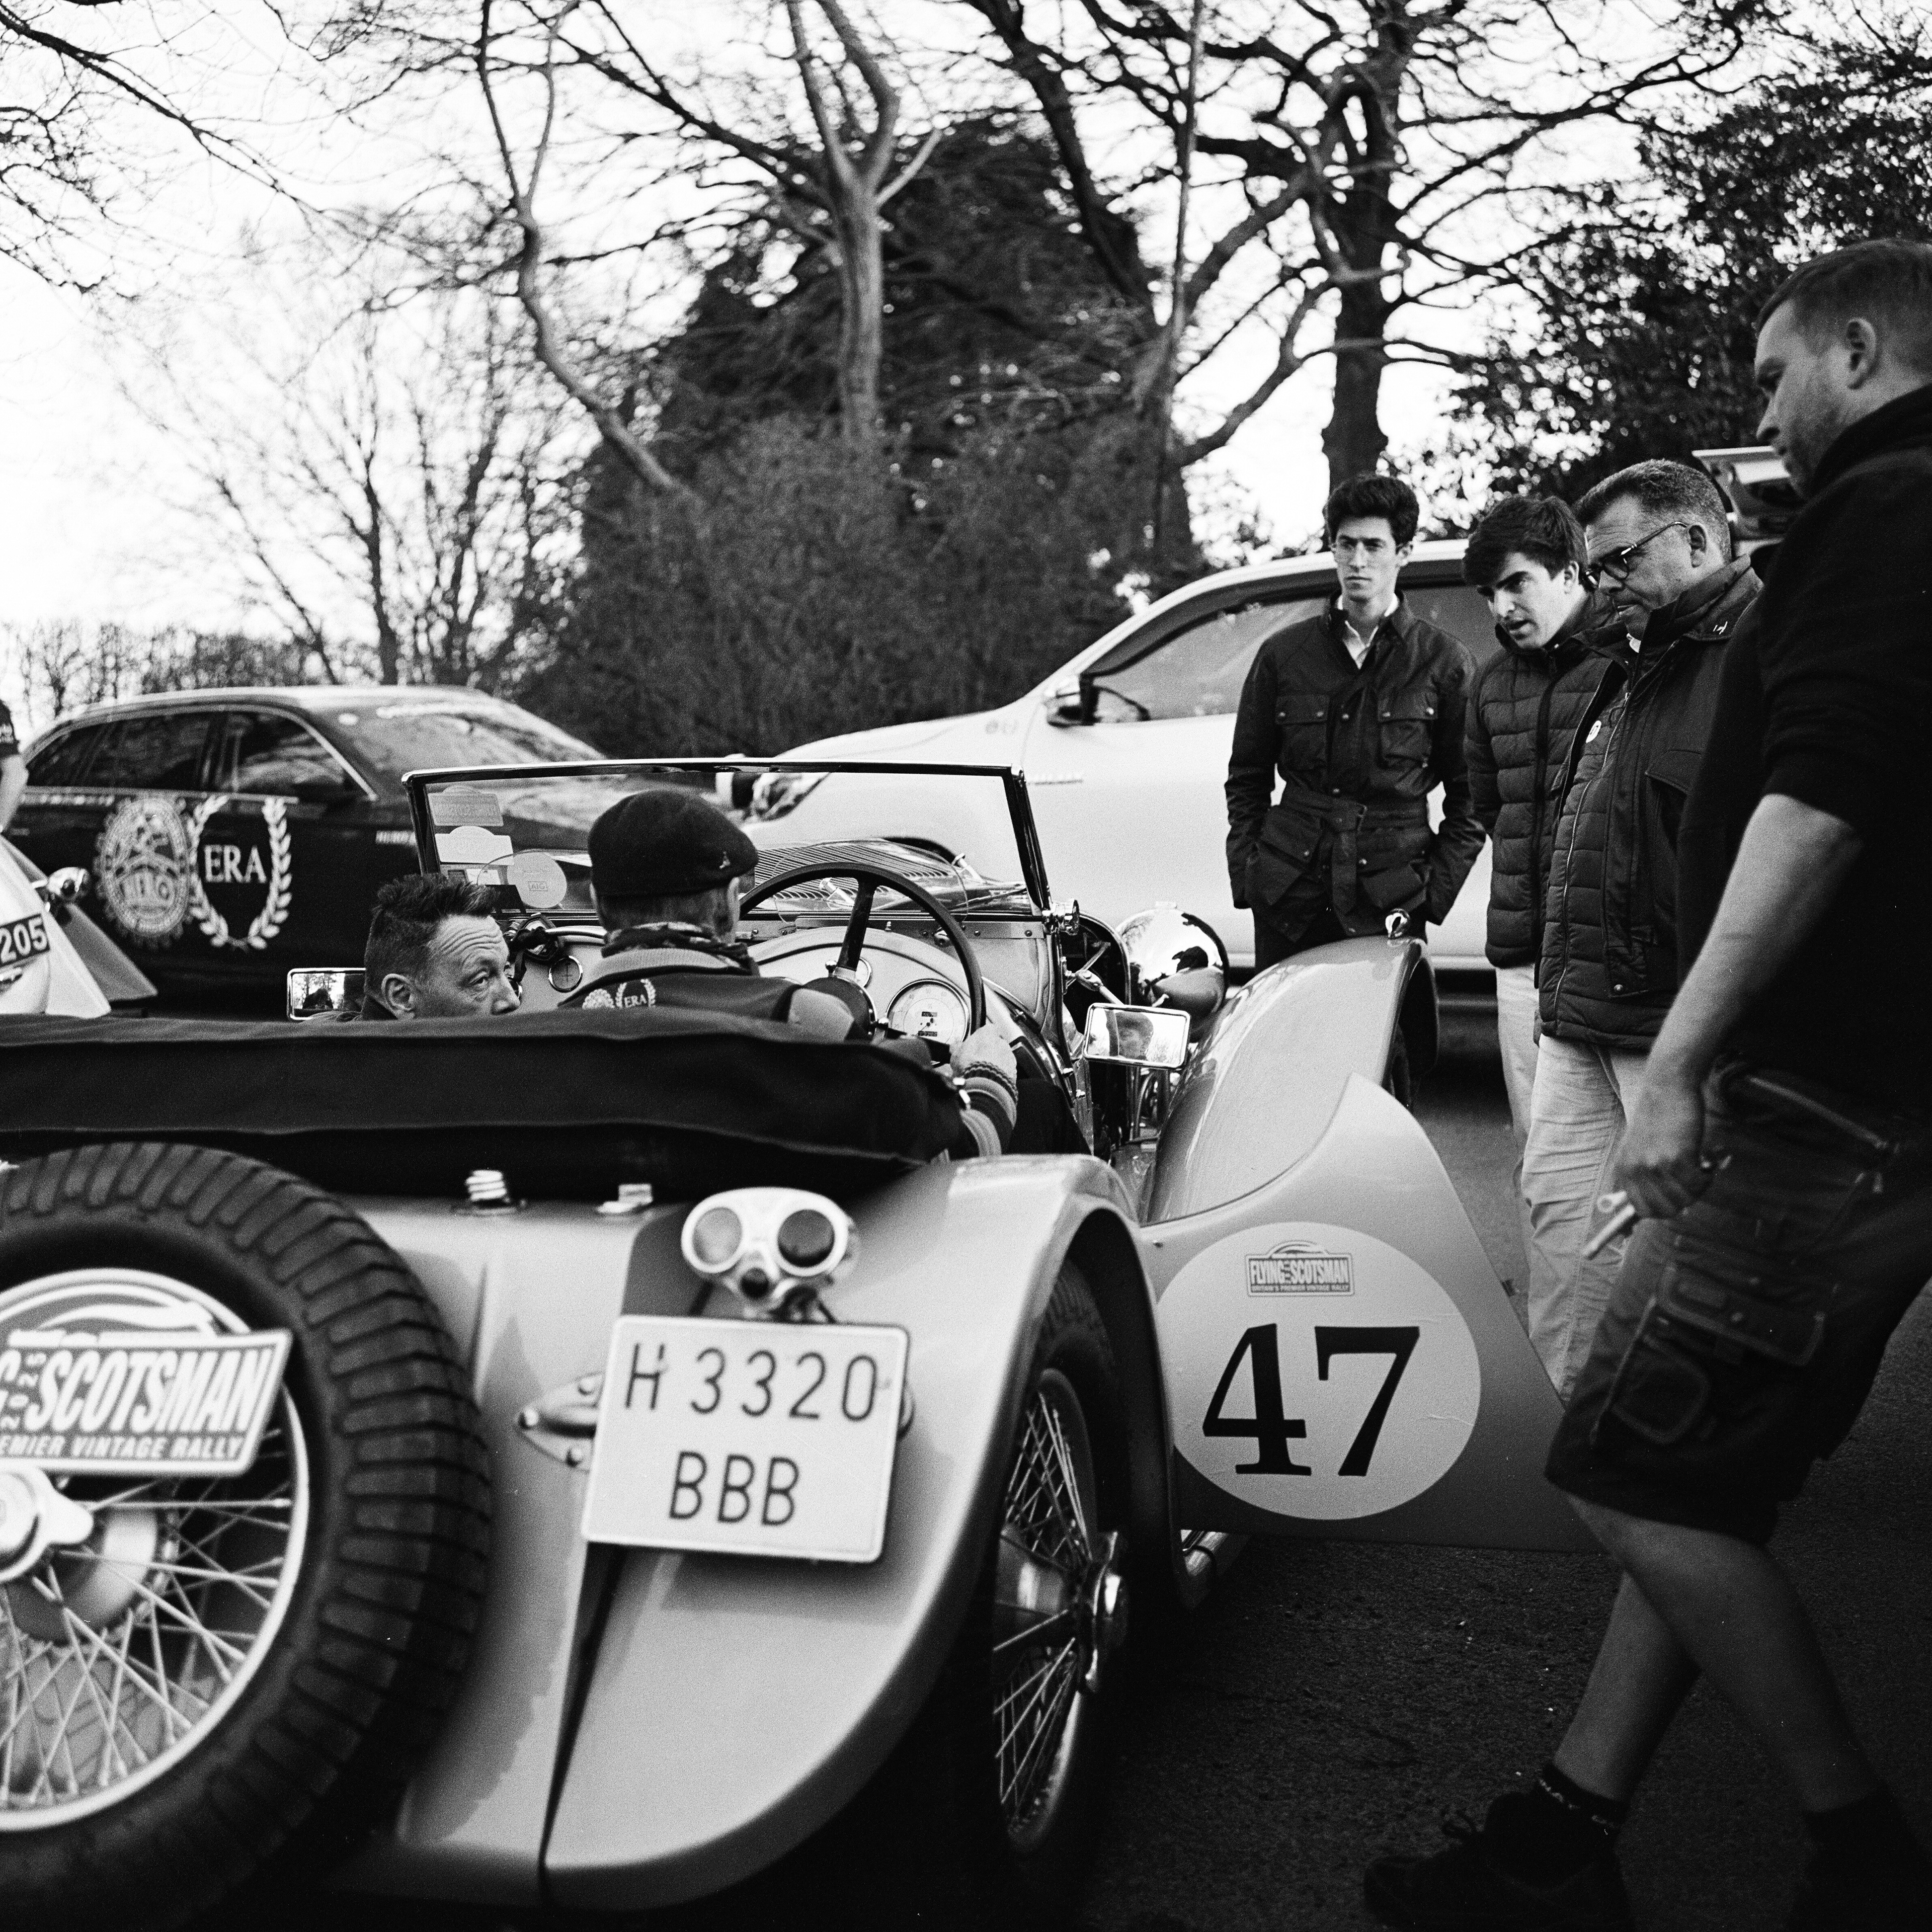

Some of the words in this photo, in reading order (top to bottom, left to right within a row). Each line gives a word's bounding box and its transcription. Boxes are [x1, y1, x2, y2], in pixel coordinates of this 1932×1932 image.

[204, 844, 267, 883] ERA
[0, 916, 48, 964] 205
[624, 994, 647, 1008] ERA
[1250, 1259, 1284, 1283] FLYING
[1290, 1259, 1349, 1283] SCOTSMAN
[24, 1348, 273, 1431] SCOTSMAN
[625, 1342, 665, 1410] H
[691, 1347, 877, 1422] 3320
[1202, 1323, 1420, 1477] 47
[70, 1436, 169, 1458] VINTAGE
[170, 1437, 246, 1458] RALLY
[670, 1452, 799, 1526] BBB
